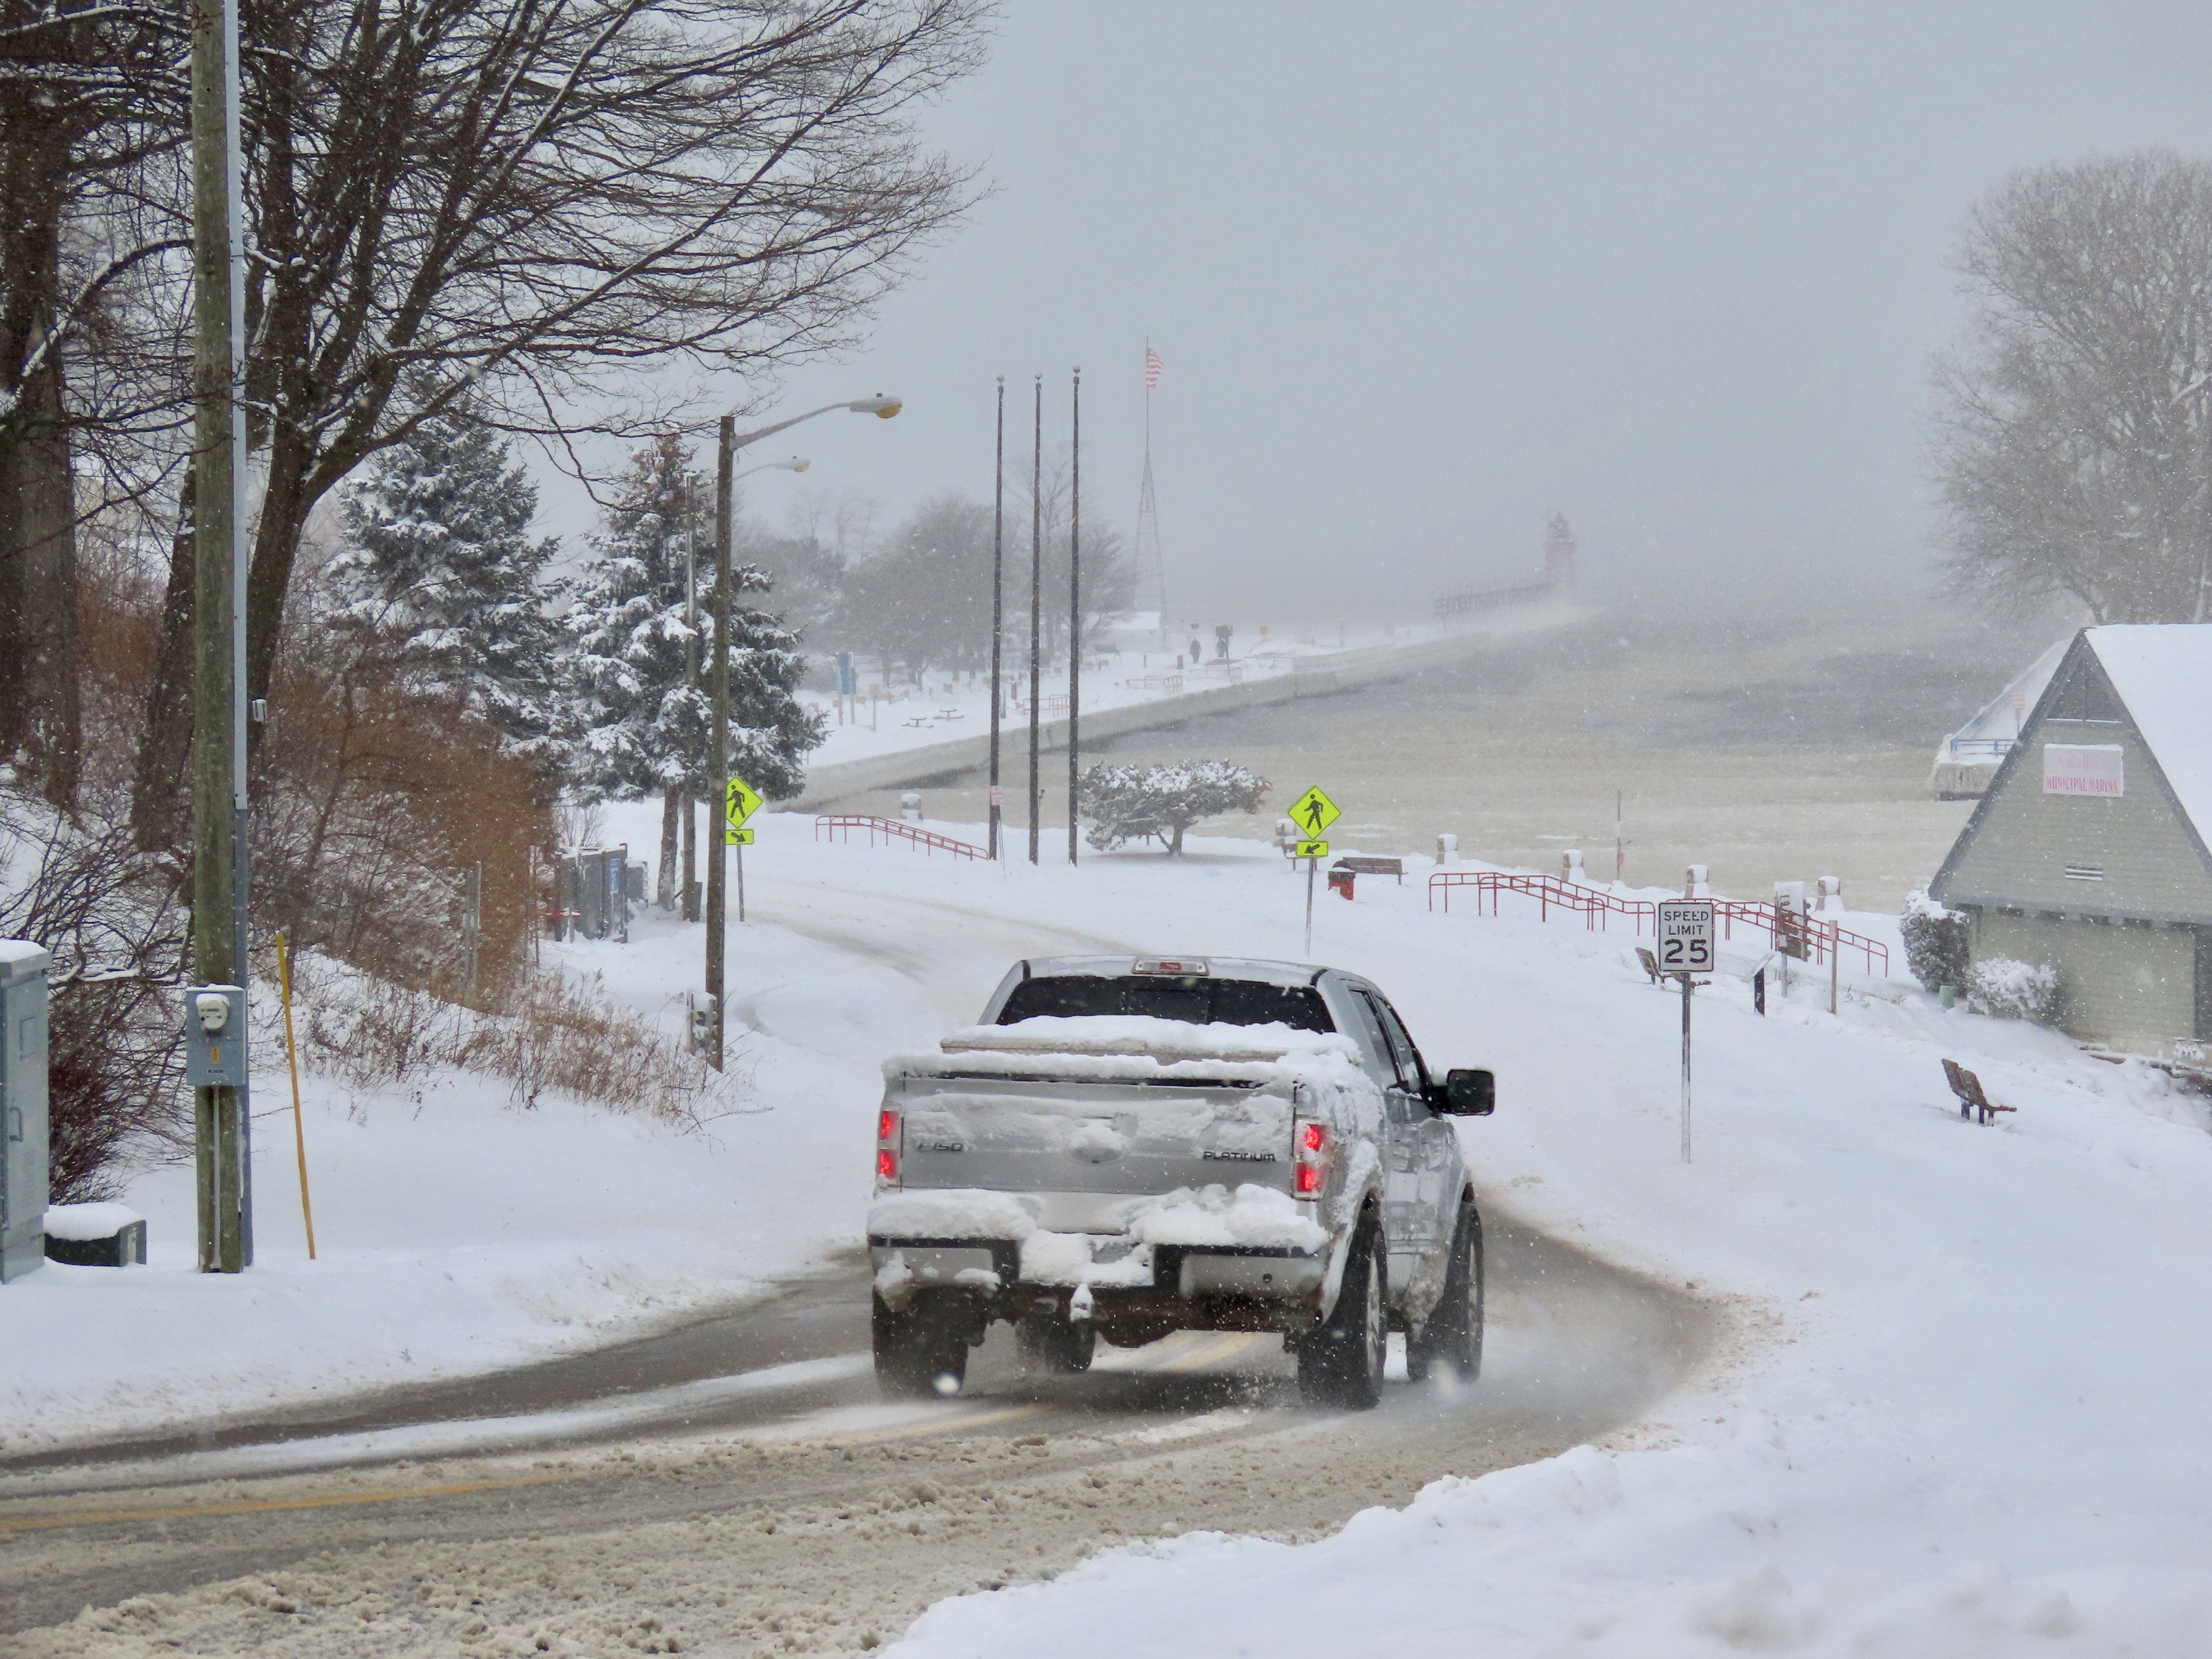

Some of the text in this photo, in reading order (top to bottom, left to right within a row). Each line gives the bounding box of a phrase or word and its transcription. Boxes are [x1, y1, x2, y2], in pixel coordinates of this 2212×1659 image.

[2047, 777, 2118, 793] MUNICIPAL MARINA
[1665, 911, 1708, 921] SPEED
[1669, 925, 1703, 935] LIMIT
[1665, 939, 1708, 963] 25
[1203, 1151, 1276, 1161] PLATINUM
